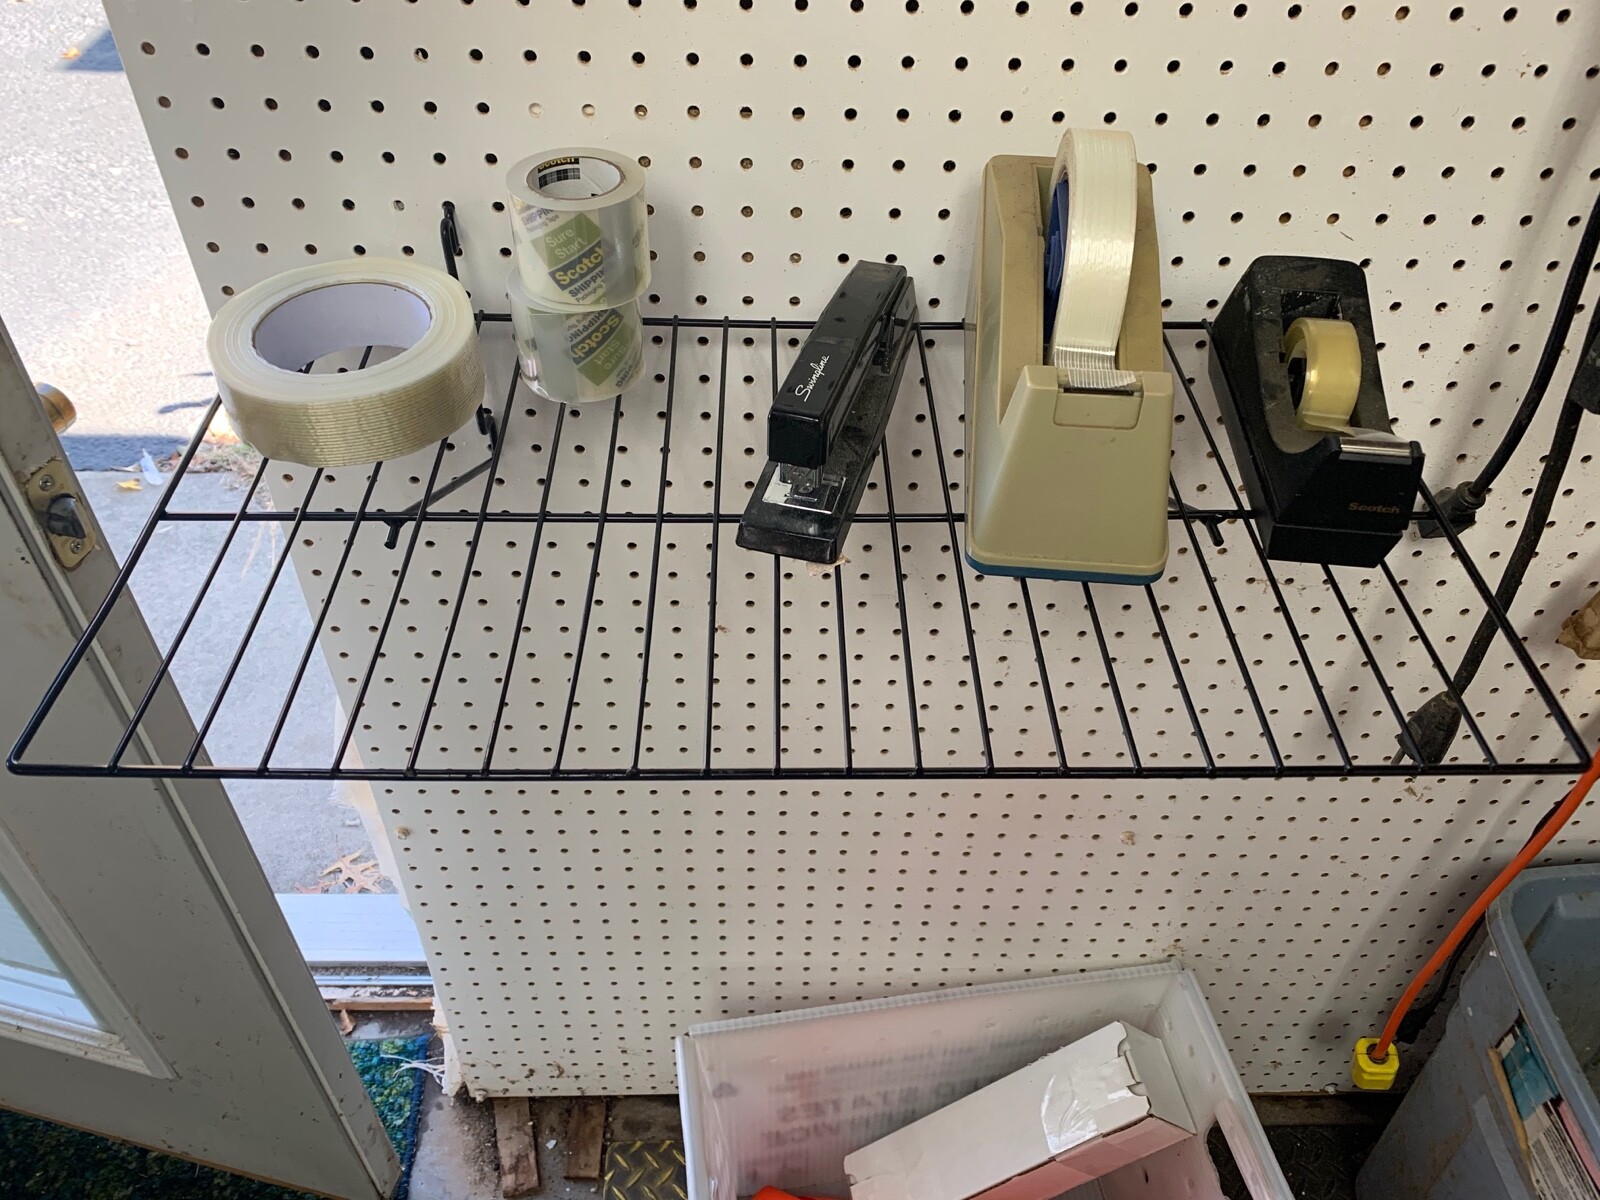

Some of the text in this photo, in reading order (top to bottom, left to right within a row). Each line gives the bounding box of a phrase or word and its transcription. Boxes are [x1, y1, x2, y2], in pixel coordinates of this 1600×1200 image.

[546, 229, 574, 247] Sure
[555, 237, 588, 260] Start
[572, 315, 619, 359] Scotch
[795, 355, 829, 402] Swingline
[1348, 502, 1399, 514] Scotch
